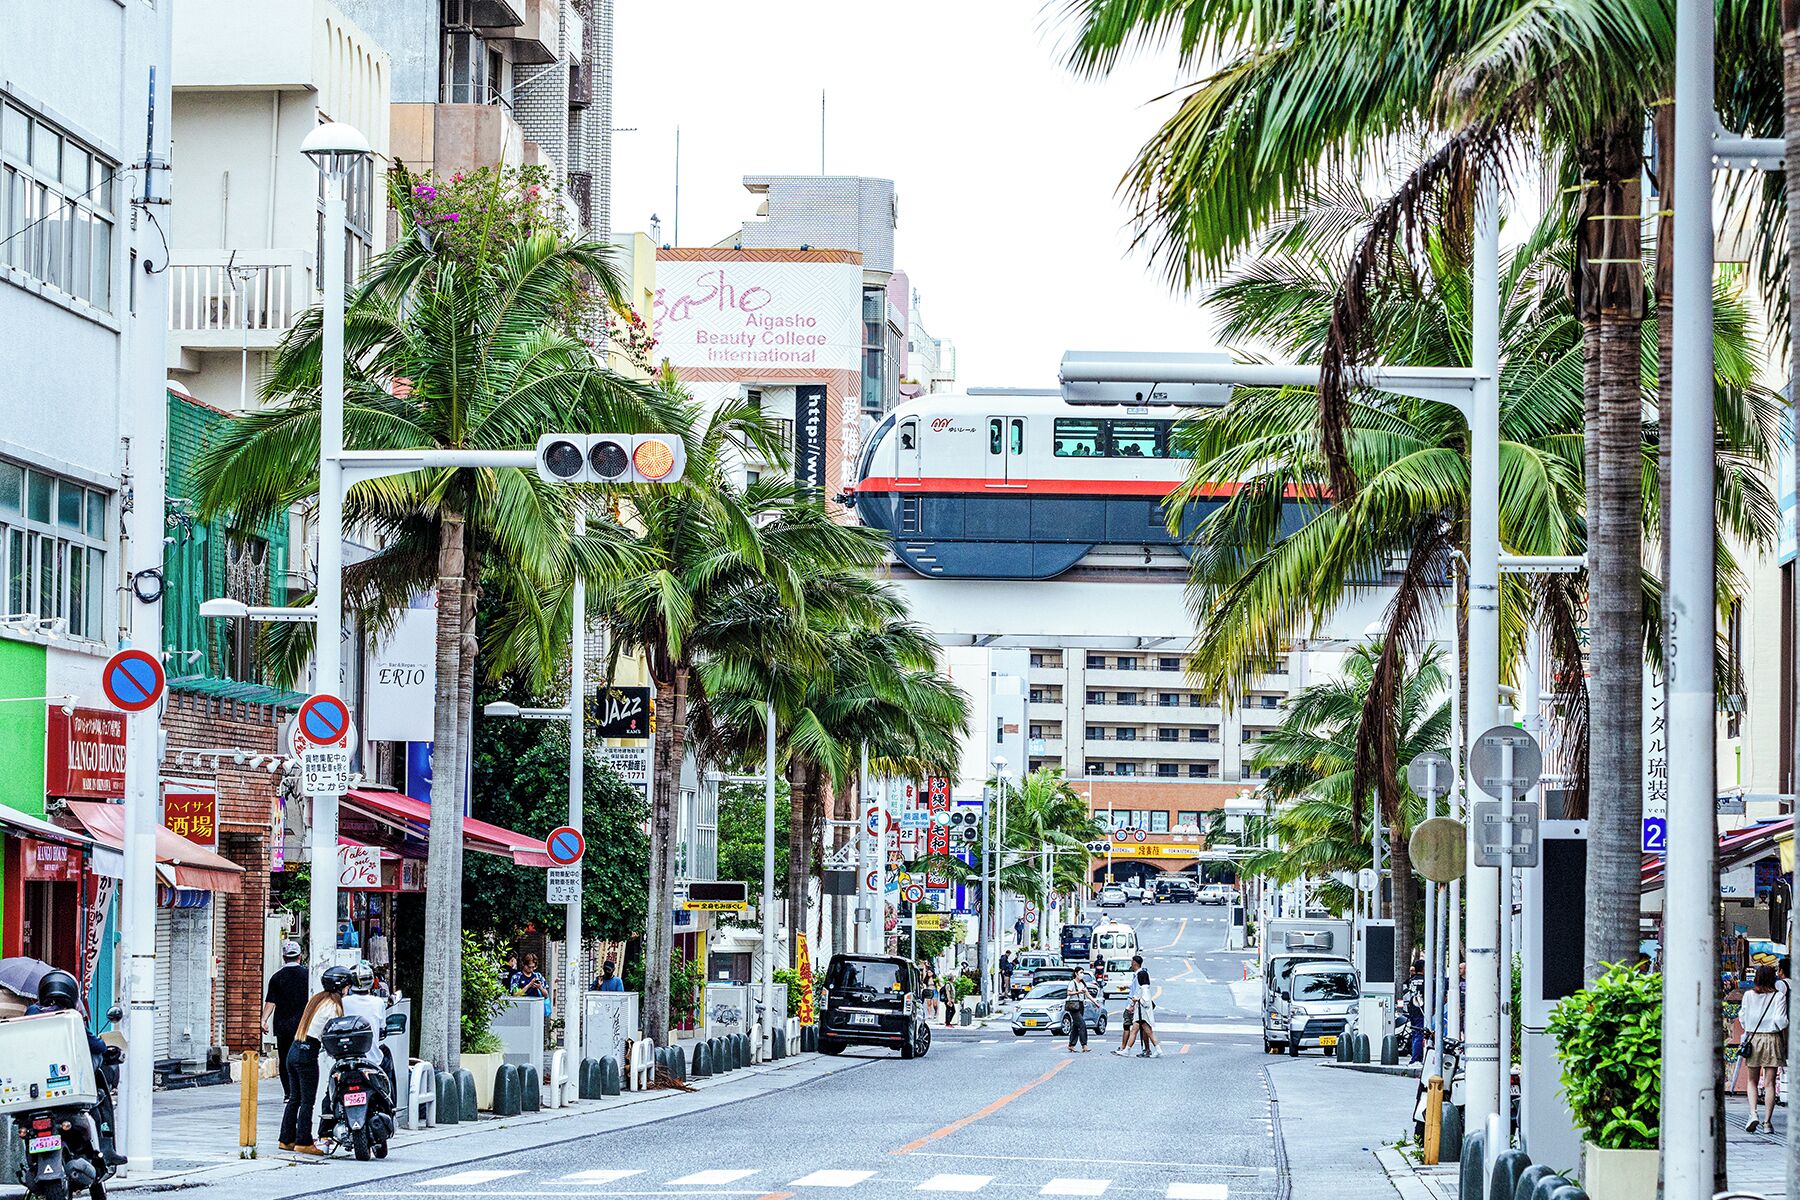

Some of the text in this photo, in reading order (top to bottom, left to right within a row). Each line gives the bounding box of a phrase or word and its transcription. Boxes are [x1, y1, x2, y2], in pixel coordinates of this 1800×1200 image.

[745, 313, 817, 331] Aigasho
[696, 330, 827, 347] Beauty College
[708, 347, 816, 362] International
[379, 668, 425, 688] ERIO
[600, 697, 642, 727] JAZZ
[68, 740, 126, 773] MANGO HOUSE
[306, 773, 317, 782] 10
[337, 773, 347, 781] 15
[306, 783, 346, 791] ここから
[166, 801, 213, 813] ハイサイ
[167, 815, 213, 837] 酒場
[901, 830, 913, 838] 2F
[337, 845, 368, 865] Take
[354, 857, 370, 866] out
[340, 866, 369, 885] OK
[799, 939, 814, 1023] 沖縄そば
